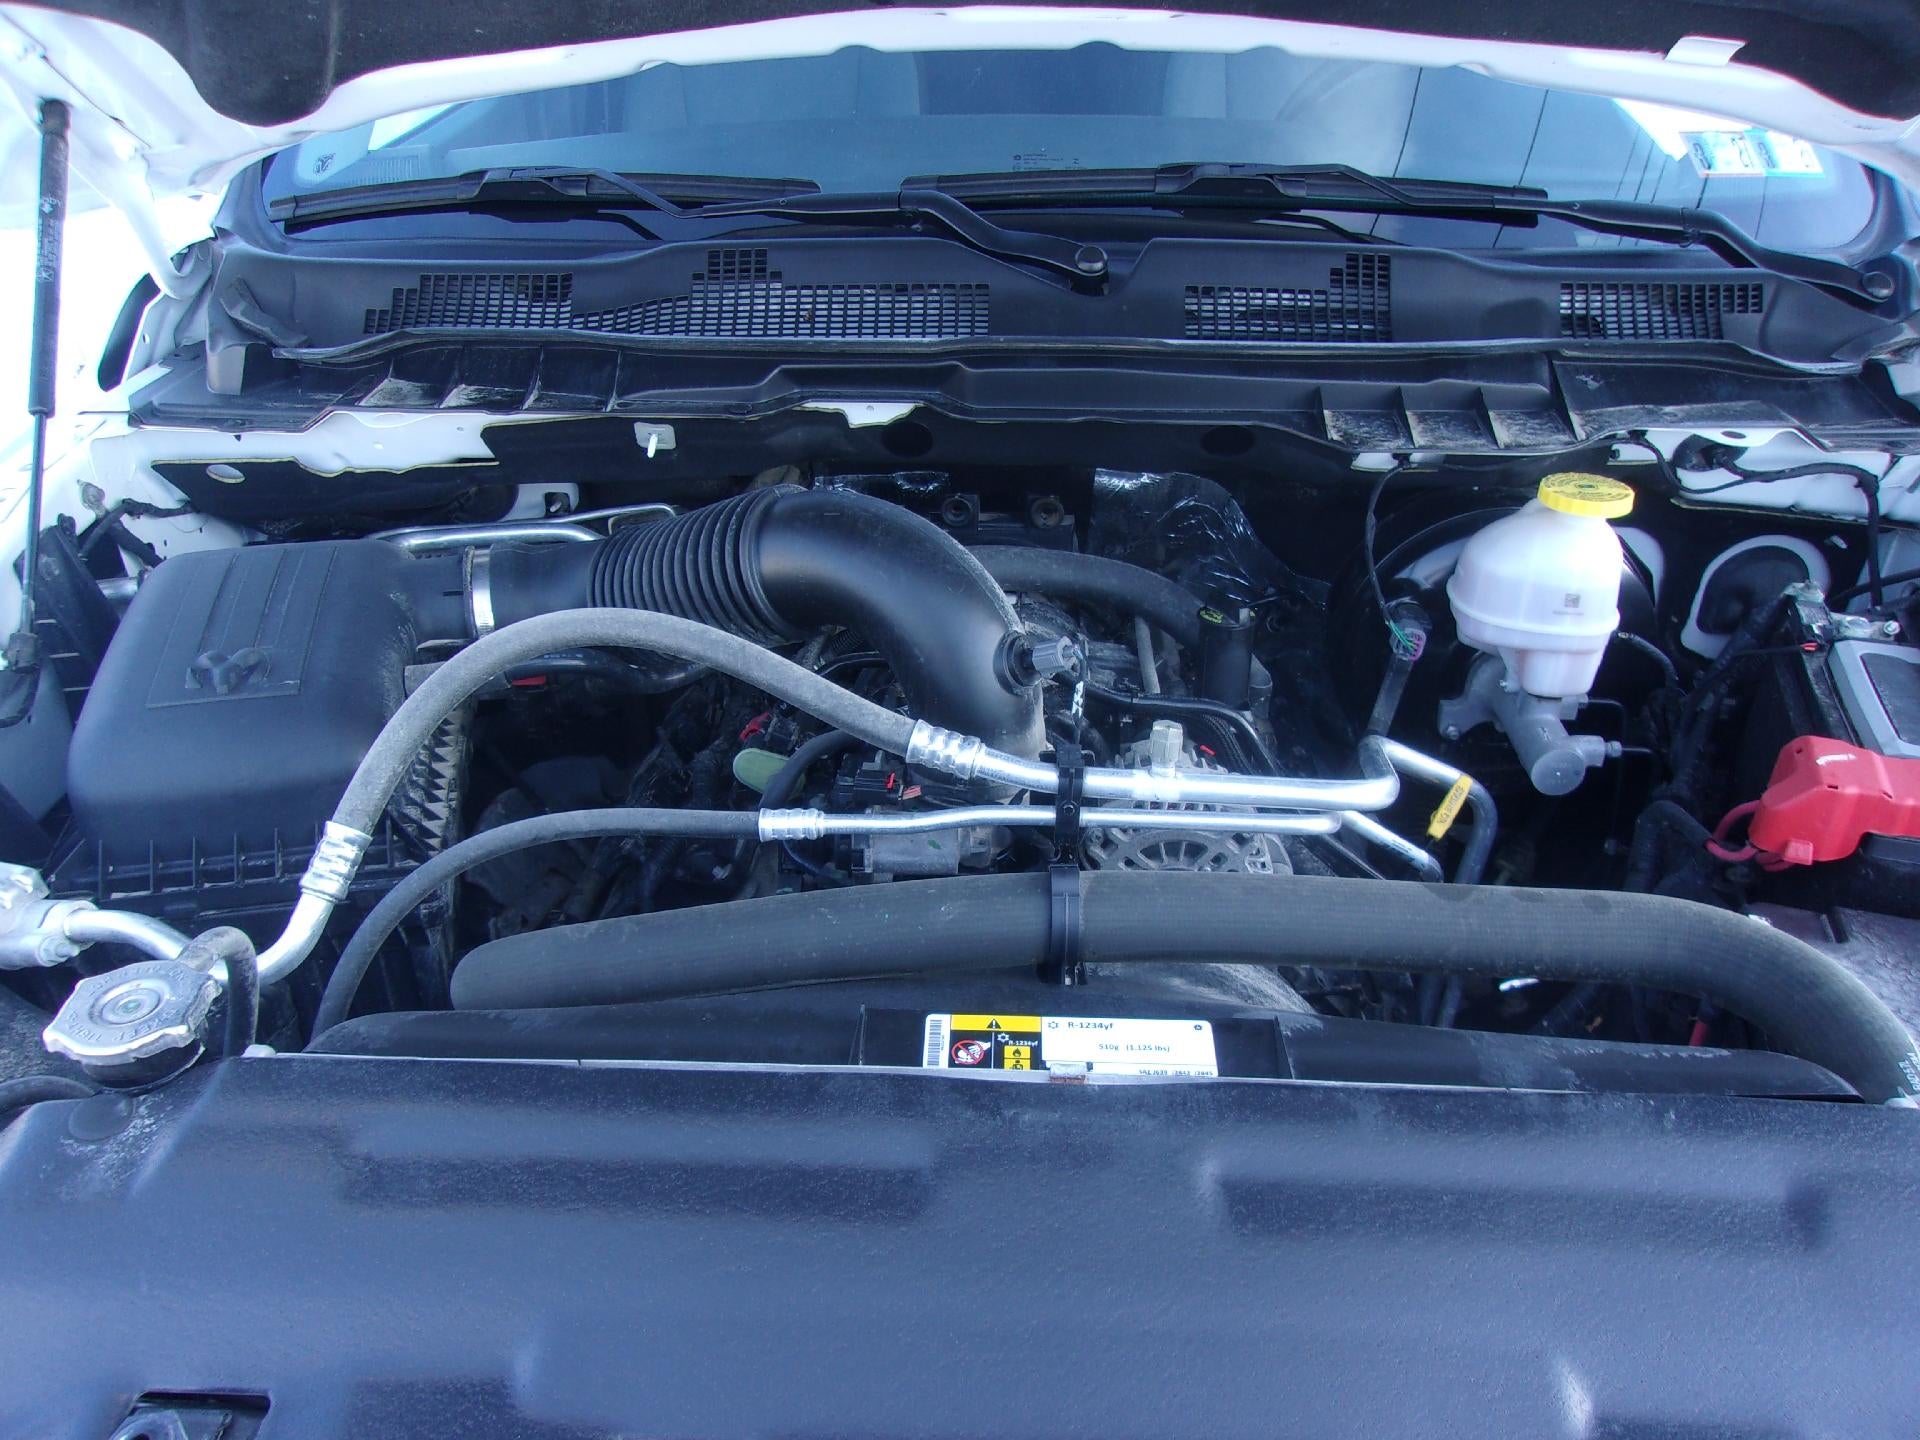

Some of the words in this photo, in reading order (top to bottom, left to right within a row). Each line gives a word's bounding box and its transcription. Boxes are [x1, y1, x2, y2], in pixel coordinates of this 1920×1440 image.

[1067, 1021, 1114, 1031] R-1234yf
[1008, 1040, 1039, 1048] R-1234yf
[1098, 1043, 1119, 1051] 510g
[1154, 1044, 1170, 1053] lbs)
